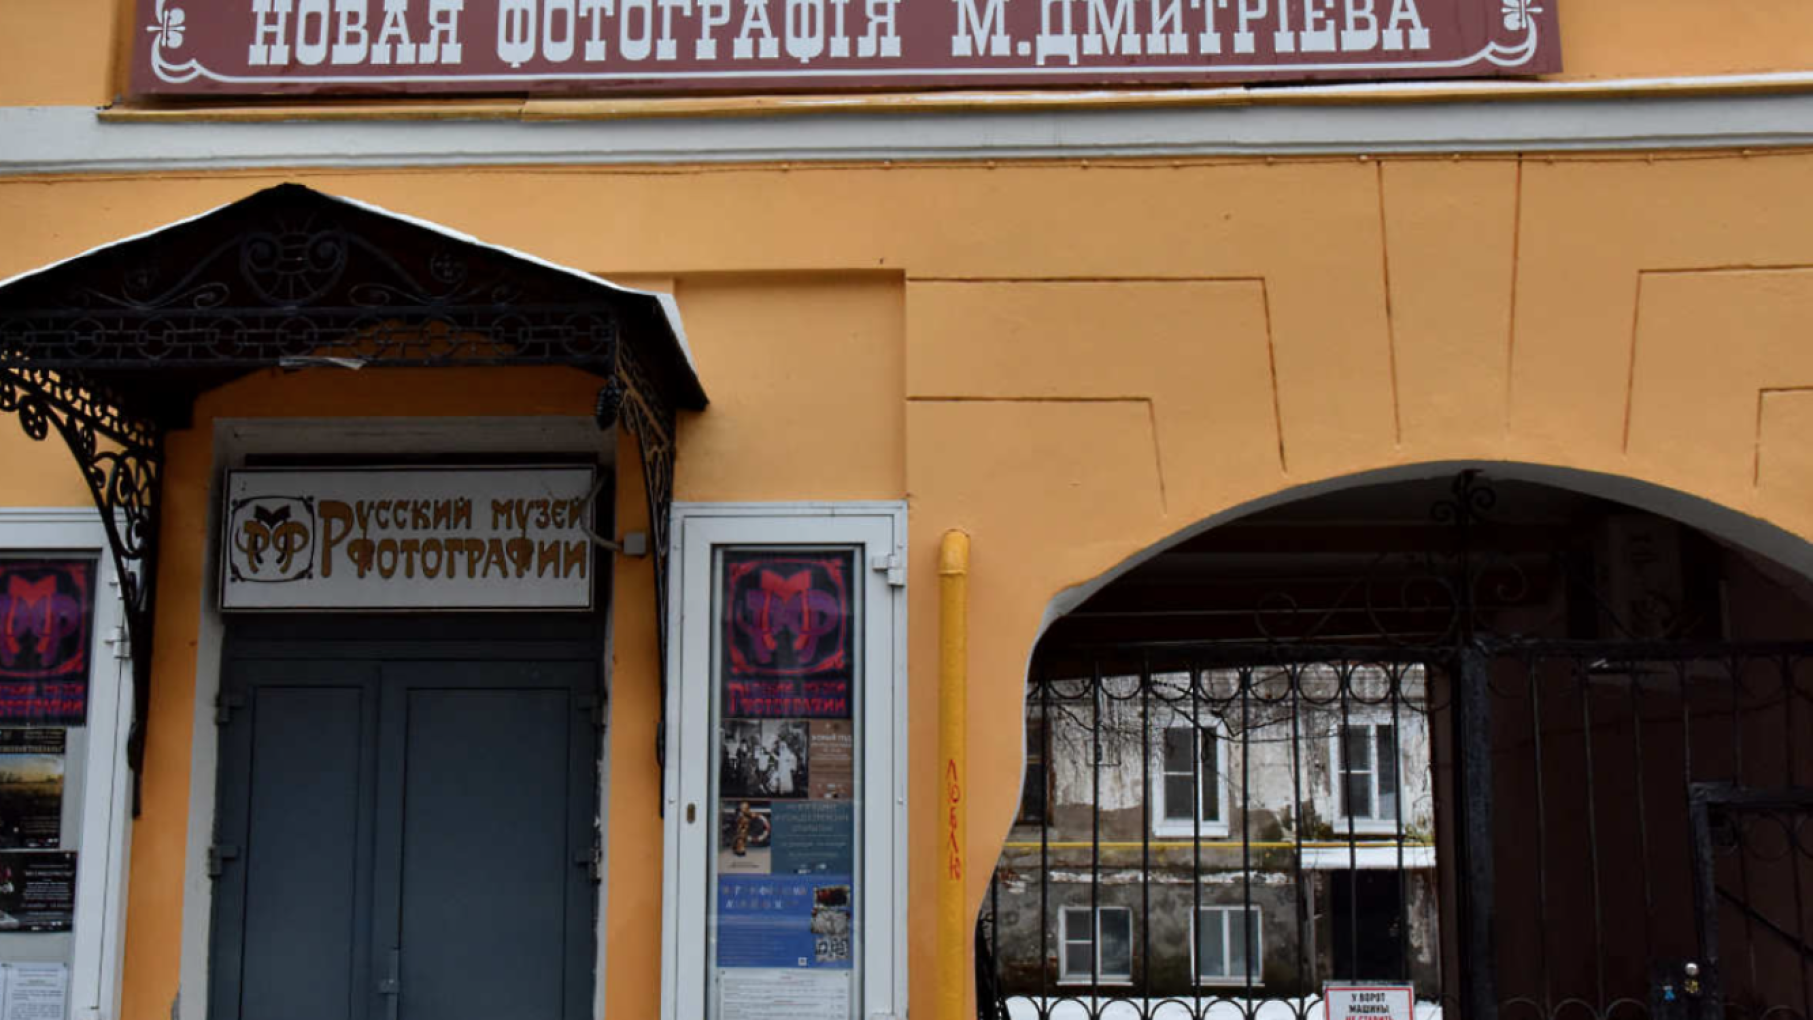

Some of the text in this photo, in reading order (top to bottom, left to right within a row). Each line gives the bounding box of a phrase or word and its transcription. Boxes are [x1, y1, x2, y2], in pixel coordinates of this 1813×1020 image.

[248, 0, 464, 65] НОВАЯ
[318, 496, 473, 578] РУССКИЙ
[347, 537, 587, 579] ФОТОГРАФИИ
[1348, 1004, 1390, 1014] МАШИНЫ
[1351, 992, 1357, 1002] У
